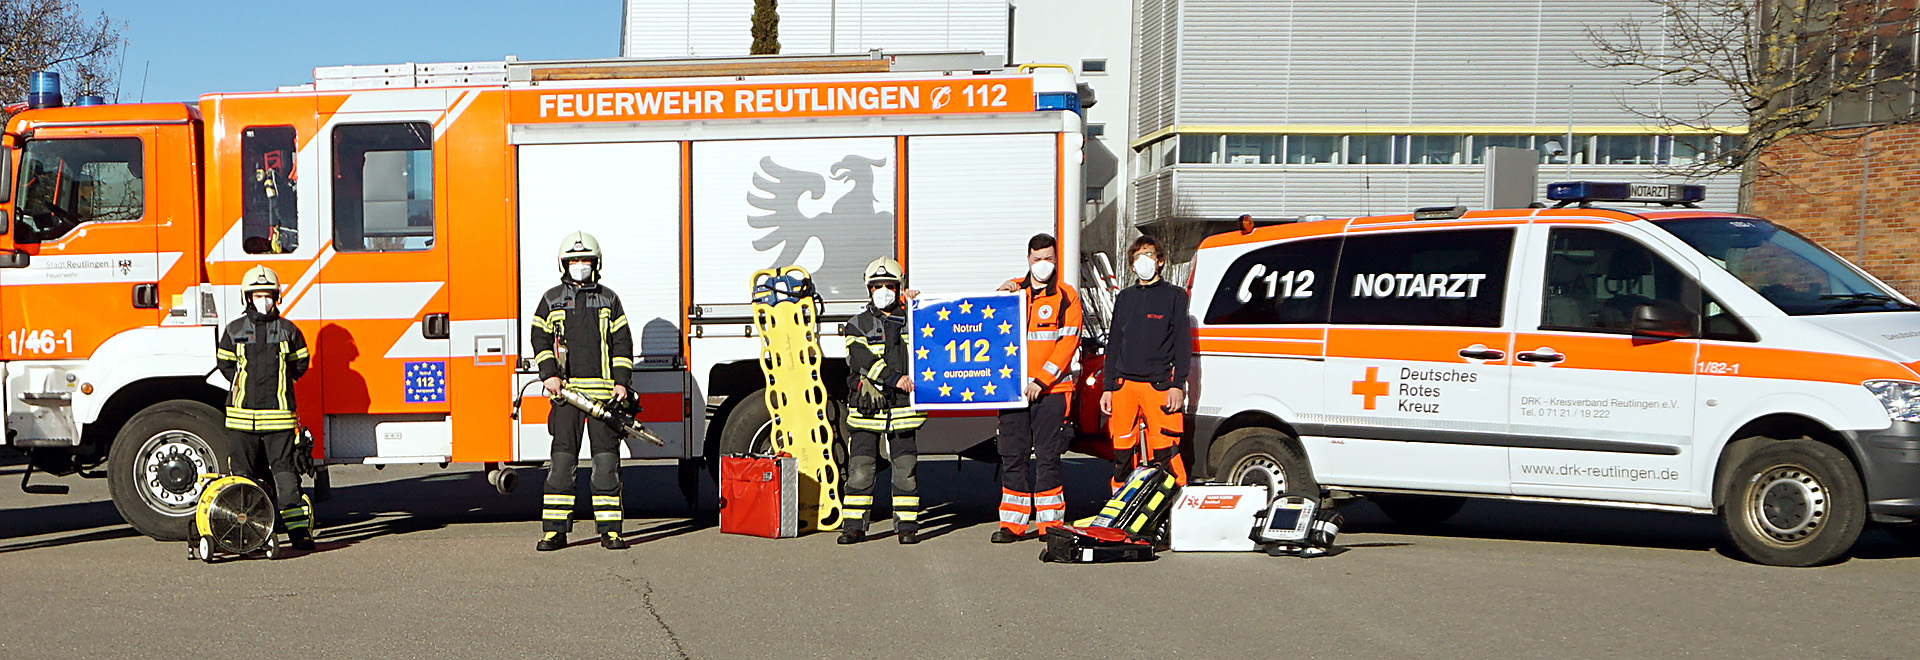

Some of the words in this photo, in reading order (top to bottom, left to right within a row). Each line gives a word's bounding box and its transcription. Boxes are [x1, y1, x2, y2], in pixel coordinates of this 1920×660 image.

[540, 90, 724, 118] FEUERWEHR
[734, 86, 919, 113] REUTLINGEN
[962, 84, 1007, 107] 112
[1631, 185, 1668, 198] NOTARZT
[46, 261, 66, 269] Stadt
[66, 260, 109, 269] Reutlingen
[1263, 269, 1315, 298] 112
[1353, 273, 1486, 298] NOTARZT
[953, 322, 983, 333] Notruf
[8, 328, 73, 356] 1/46-1
[944, 338, 991, 363] 112
[943, 368, 991, 379] europaweit
[1698, 361, 1740, 374] 1/82-1
[416, 377, 435, 387] 112
[1400, 367, 1478, 383] Deutsches
[1399, 383, 1441, 397] Rotes
[1398, 399, 1440, 413] Kreuz
[1521, 397, 1541, 405] DRK
[1550, 397, 1608, 407] Kreisverband
[1611, 398, 1659, 410] Reutlingen
[1662, 400, 1680, 409] e.V.
[1521, 408, 1536, 416] Tel.
[1547, 408, 1557, 417] 71
[1560, 409, 1571, 417] 21
[1581, 409, 1591, 417] 19
[1593, 409, 1610, 418] 222
[1521, 464, 1679, 481] www.drk-reutlingen.de
